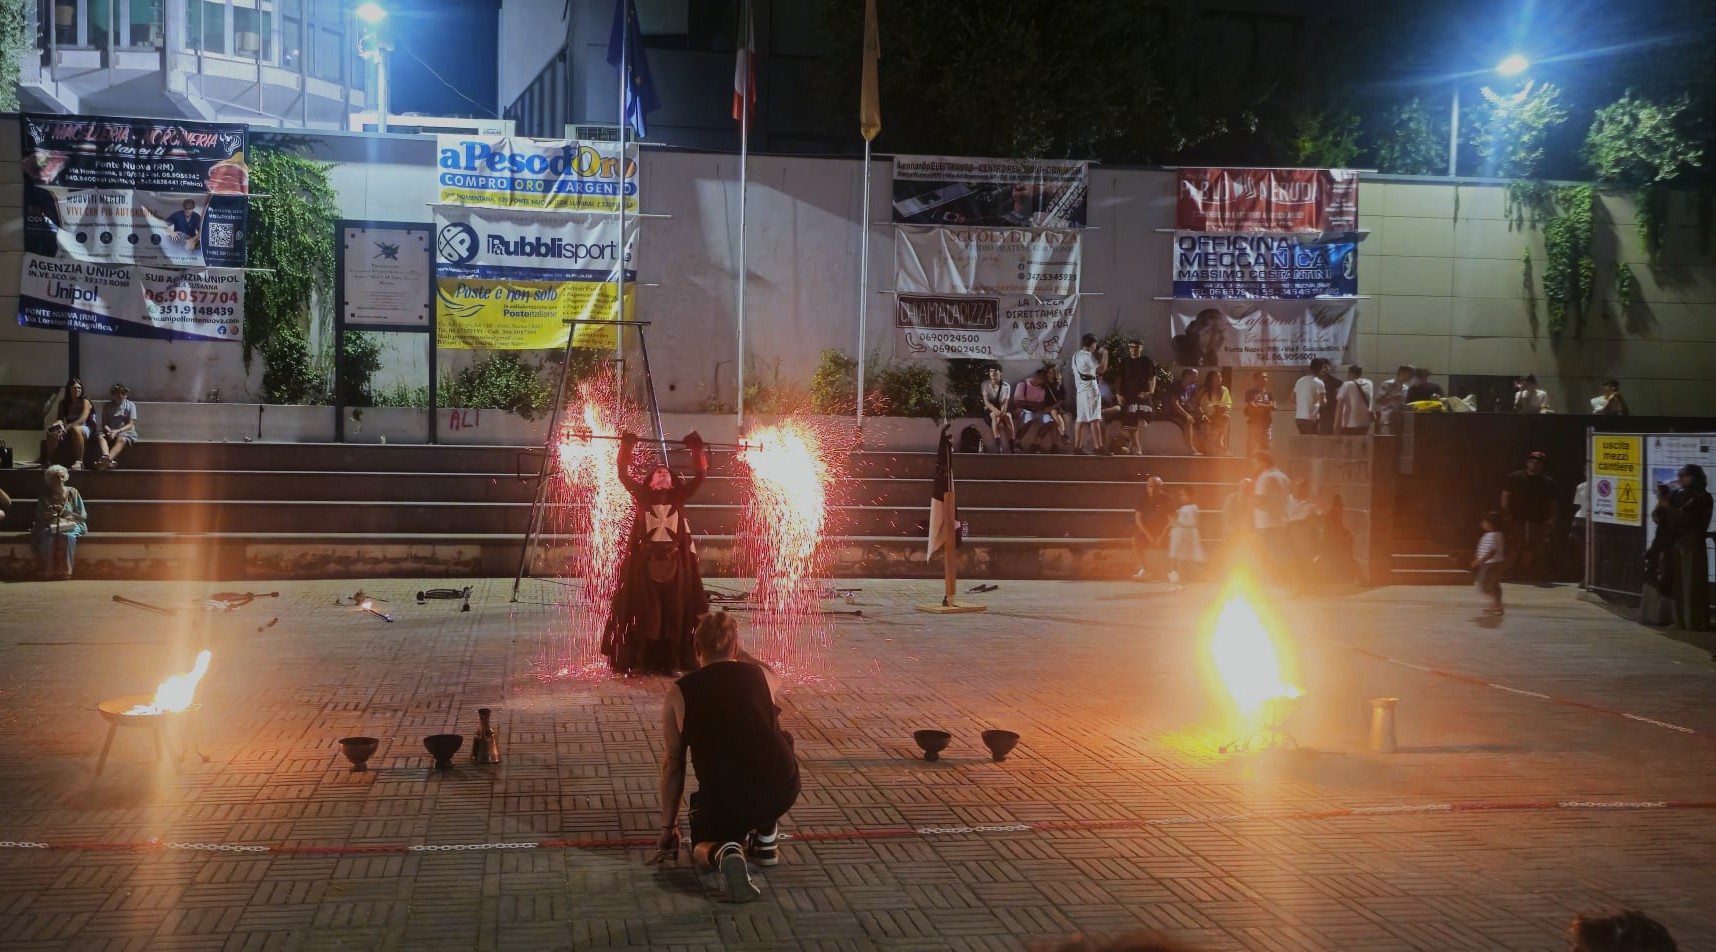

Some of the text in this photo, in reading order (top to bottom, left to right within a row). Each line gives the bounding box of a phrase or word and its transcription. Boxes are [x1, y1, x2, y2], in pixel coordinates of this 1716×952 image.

[153, 163, 174, 172] (RM)
[445, 174, 507, 189] COMPRO
[515, 178, 545, 192] ORO
[566, 182, 632, 194] ARGENTO
[1178, 236, 1291, 251] OFFICINA
[1178, 252, 1331, 268] MECCANICA
[29, 259, 131, 280] AGENZIA UNIPOL
[1178, 269, 1333, 281] MASSIMO COSTANTINI
[144, 273, 239, 284] SUB AGNZIA UNIPOL
[46, 280, 98, 304] Unipol
[144, 288, 238, 304] 06.9057704
[455, 283, 558, 303] Poste e non solo
[1018, 298, 1030, 307] LA
[25, 307, 51, 316] FONTE
[79, 313, 97, 321] (RM)
[159, 305, 234, 316] 351.9148439
[503, 309, 557, 318] Posteitaliane
[900, 301, 994, 326] CHIAMALAPIZZA
[1006, 309, 1075, 318] DIRETTAMENTE
[1013, 322, 1019, 330] A
[1024, 321, 1048, 330] CASA
[919, 333, 980, 343] 0690024500
[932, 344, 993, 355] 0690024501
[449, 409, 480, 431] ALI
[1602, 441, 1630, 450] uscita
[1603, 452, 1629, 461] mezzi
[1598, 463, 1634, 472] cantiere
